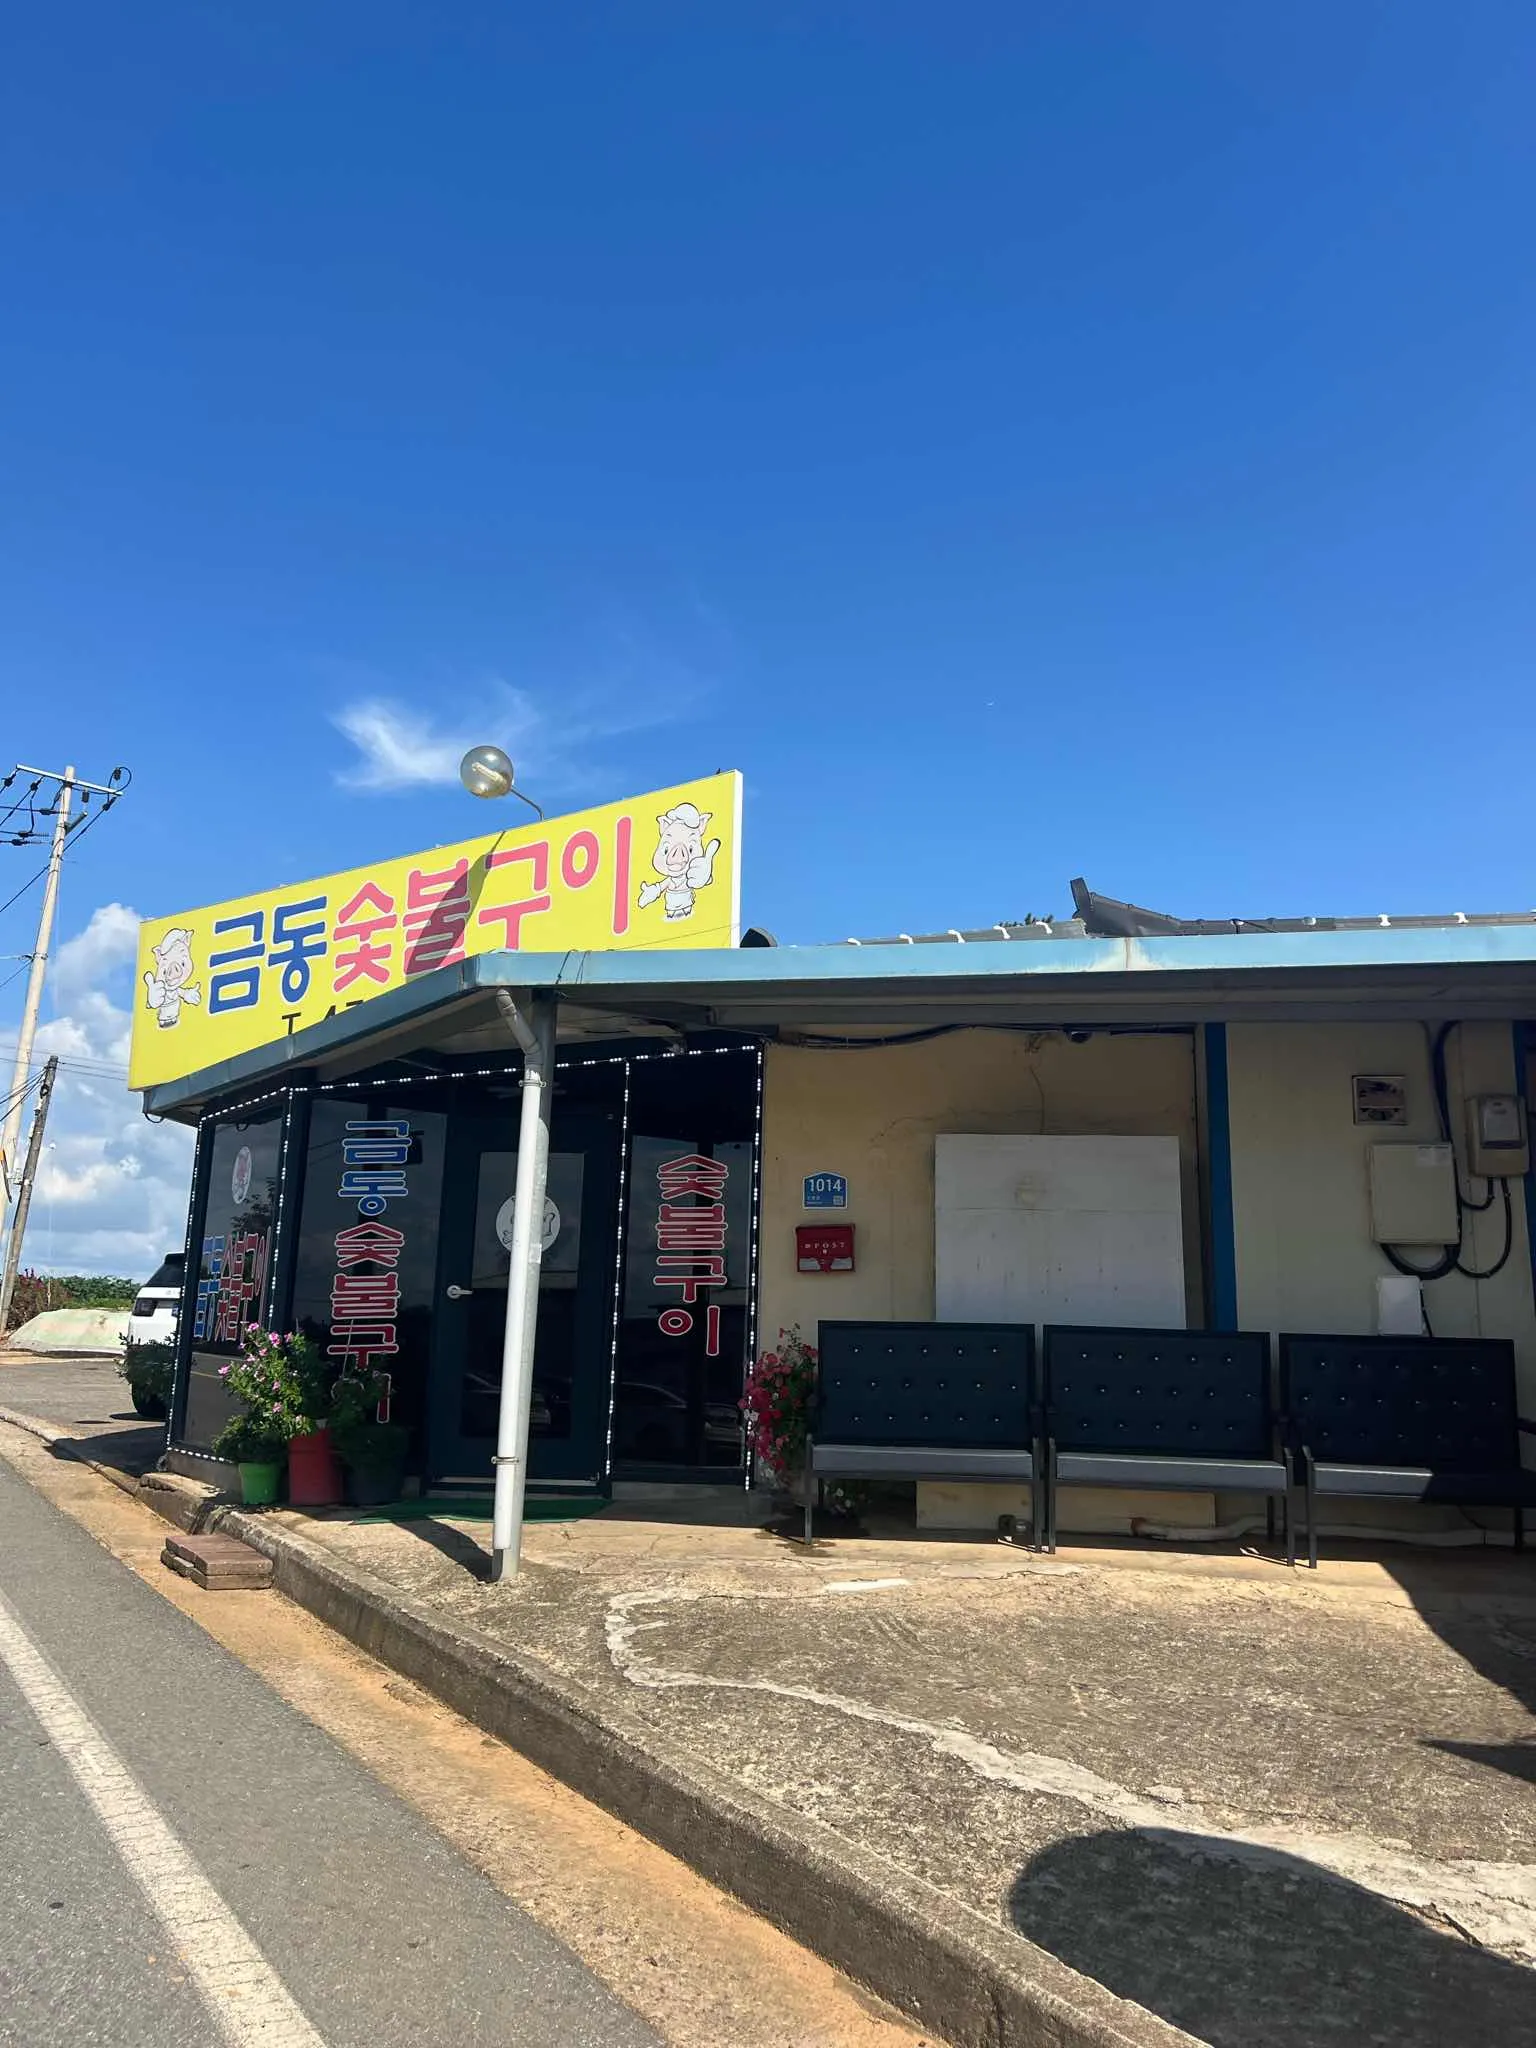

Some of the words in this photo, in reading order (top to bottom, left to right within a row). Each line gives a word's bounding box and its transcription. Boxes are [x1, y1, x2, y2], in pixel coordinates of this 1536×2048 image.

[208, 816, 632, 1015] 금동숯불구이
[653, 1153, 729, 1356] 숯불구이
[808, 1178, 842, 1192] 1014
